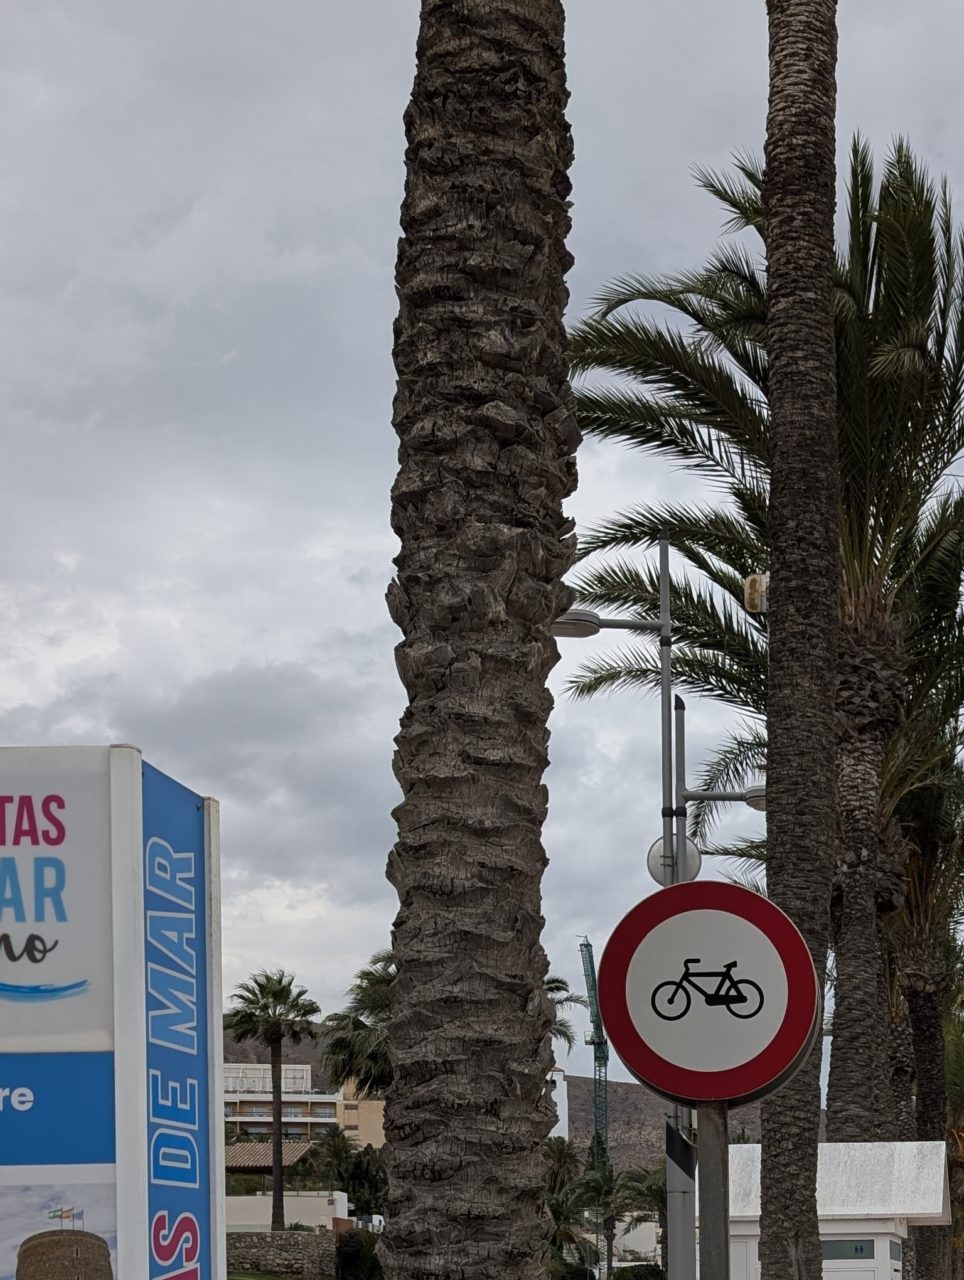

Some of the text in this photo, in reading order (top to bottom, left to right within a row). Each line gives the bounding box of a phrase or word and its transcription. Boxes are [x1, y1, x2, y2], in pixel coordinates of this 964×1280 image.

[0, 794, 66, 846] TAS
[0, 856, 68, 923] AR
[145, 836, 198, 1056] MAR
[0, 1087, 34, 1111] re
[149, 1068, 199, 1189] DE
